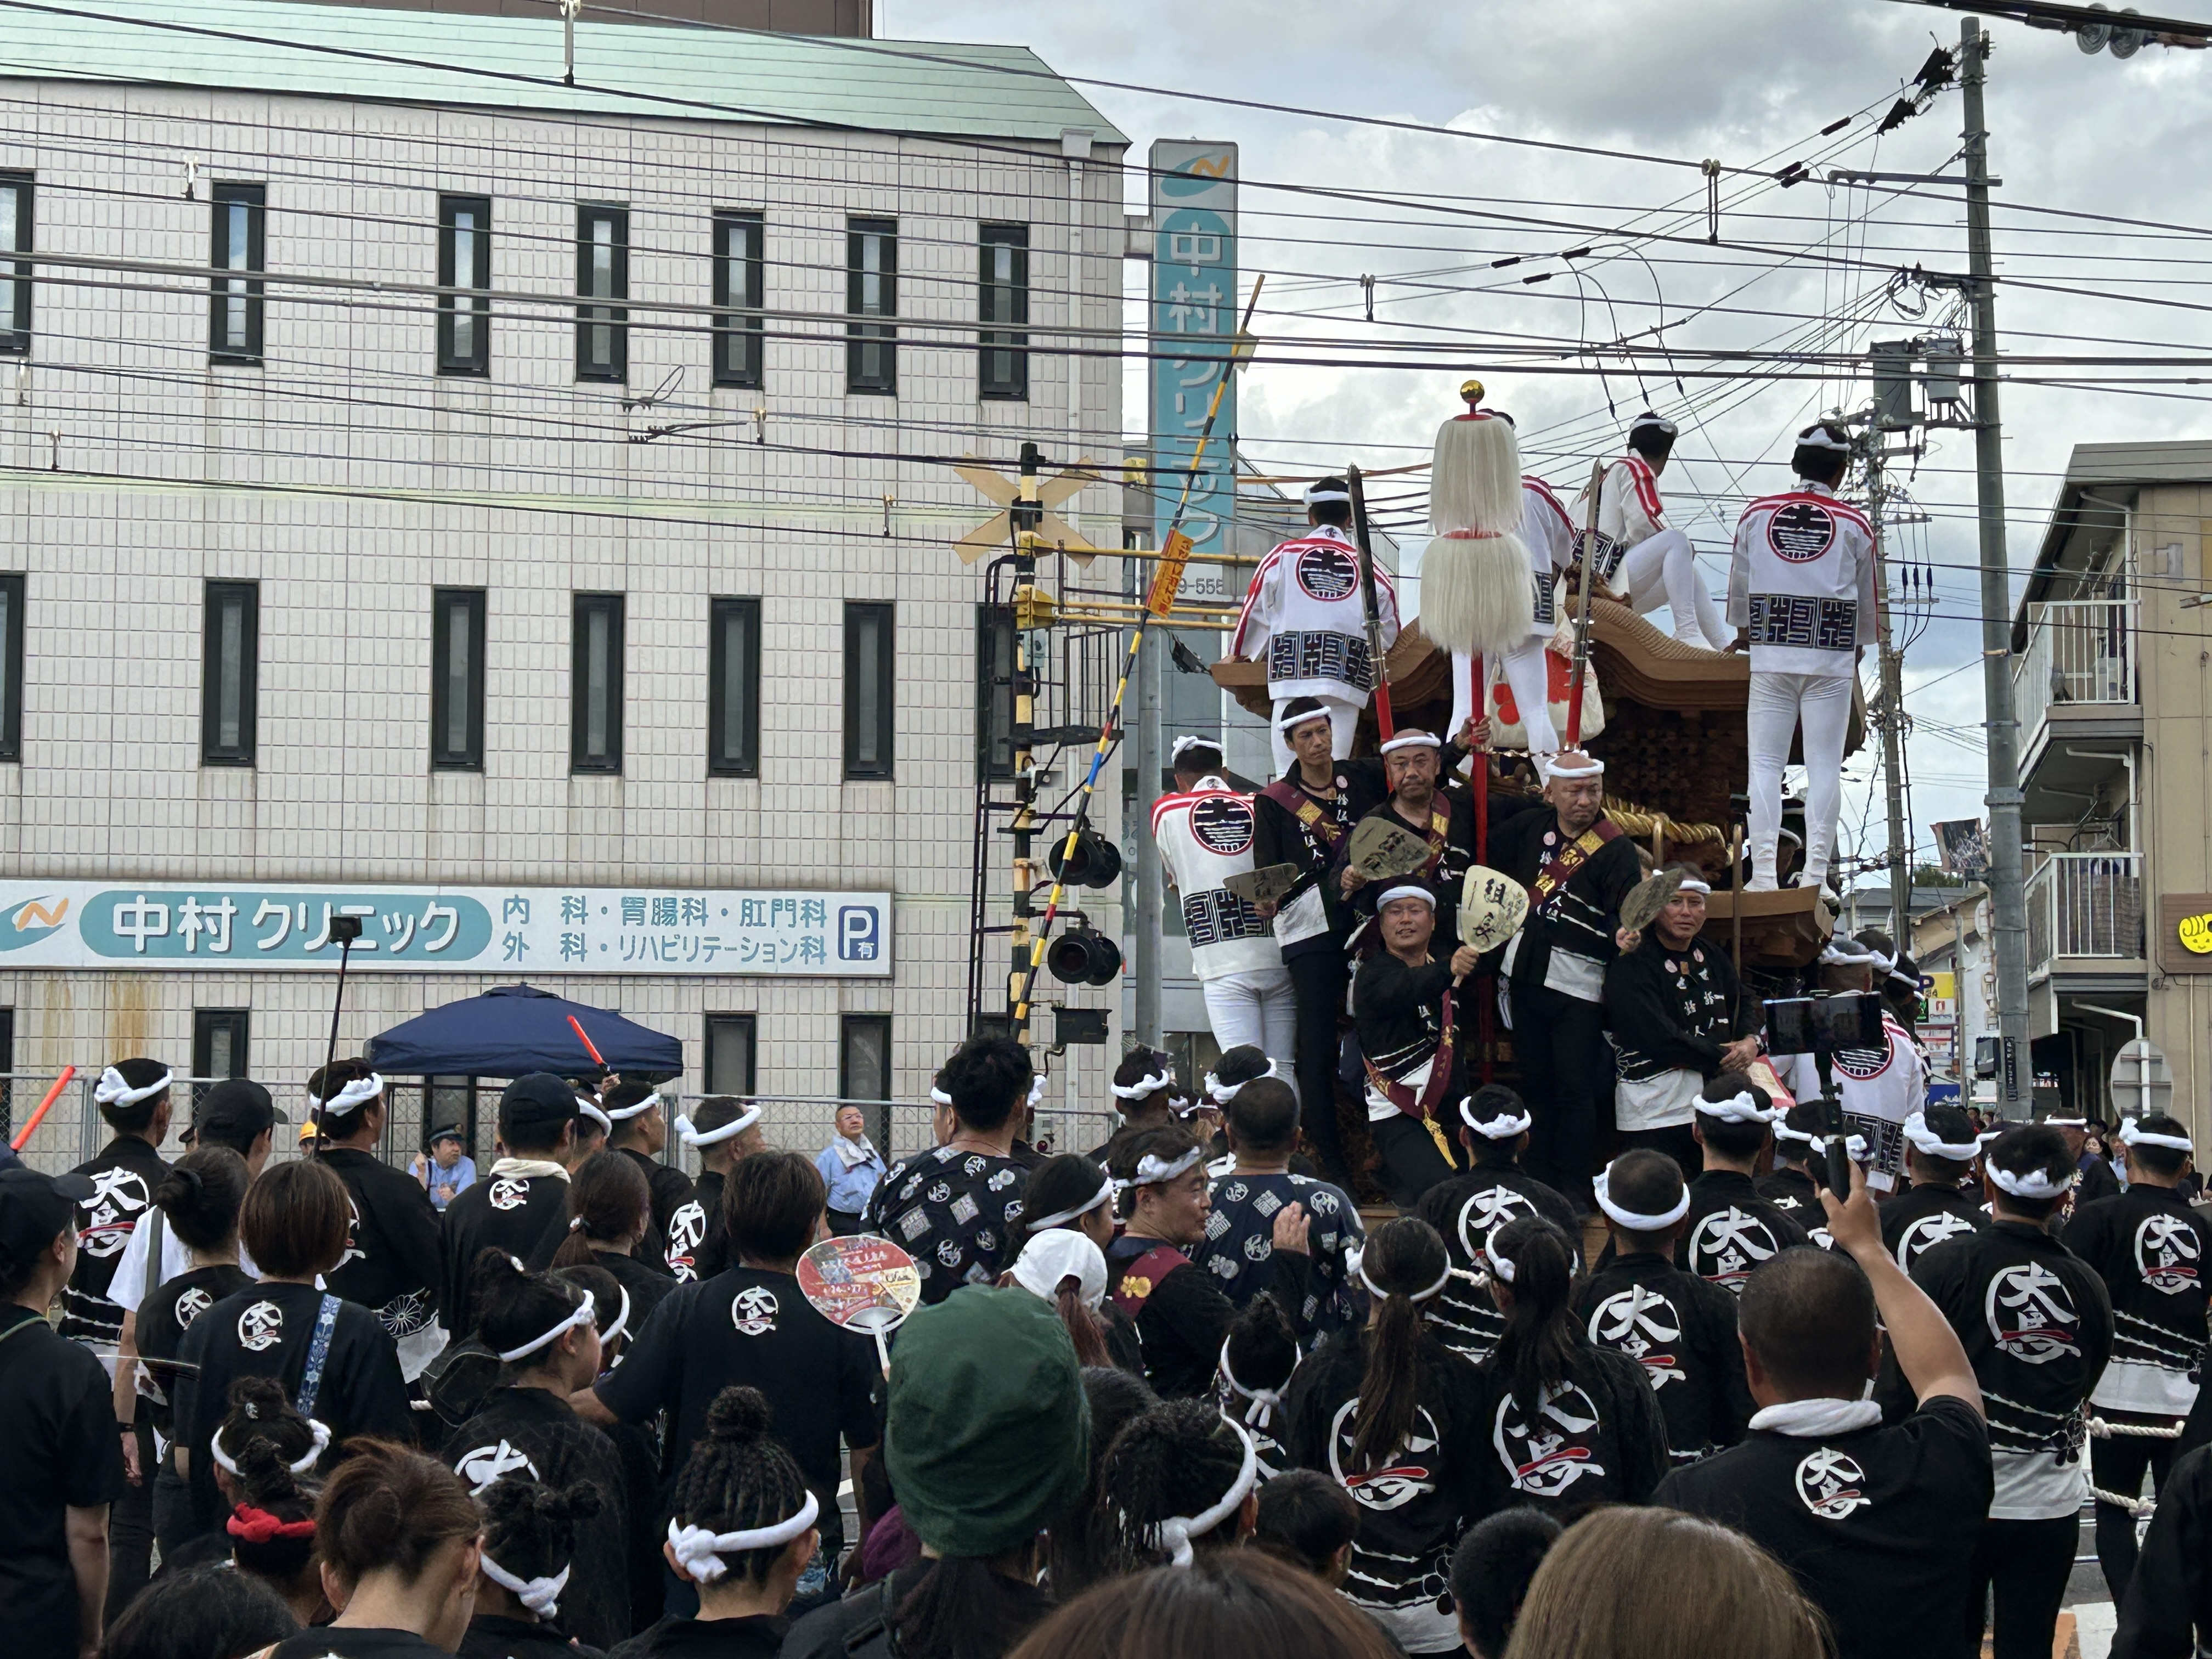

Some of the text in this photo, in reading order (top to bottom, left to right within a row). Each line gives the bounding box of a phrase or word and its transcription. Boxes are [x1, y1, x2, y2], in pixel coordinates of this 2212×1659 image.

[113, 894, 460, 953] 中村クリニック
[844, 910, 872, 958] P
